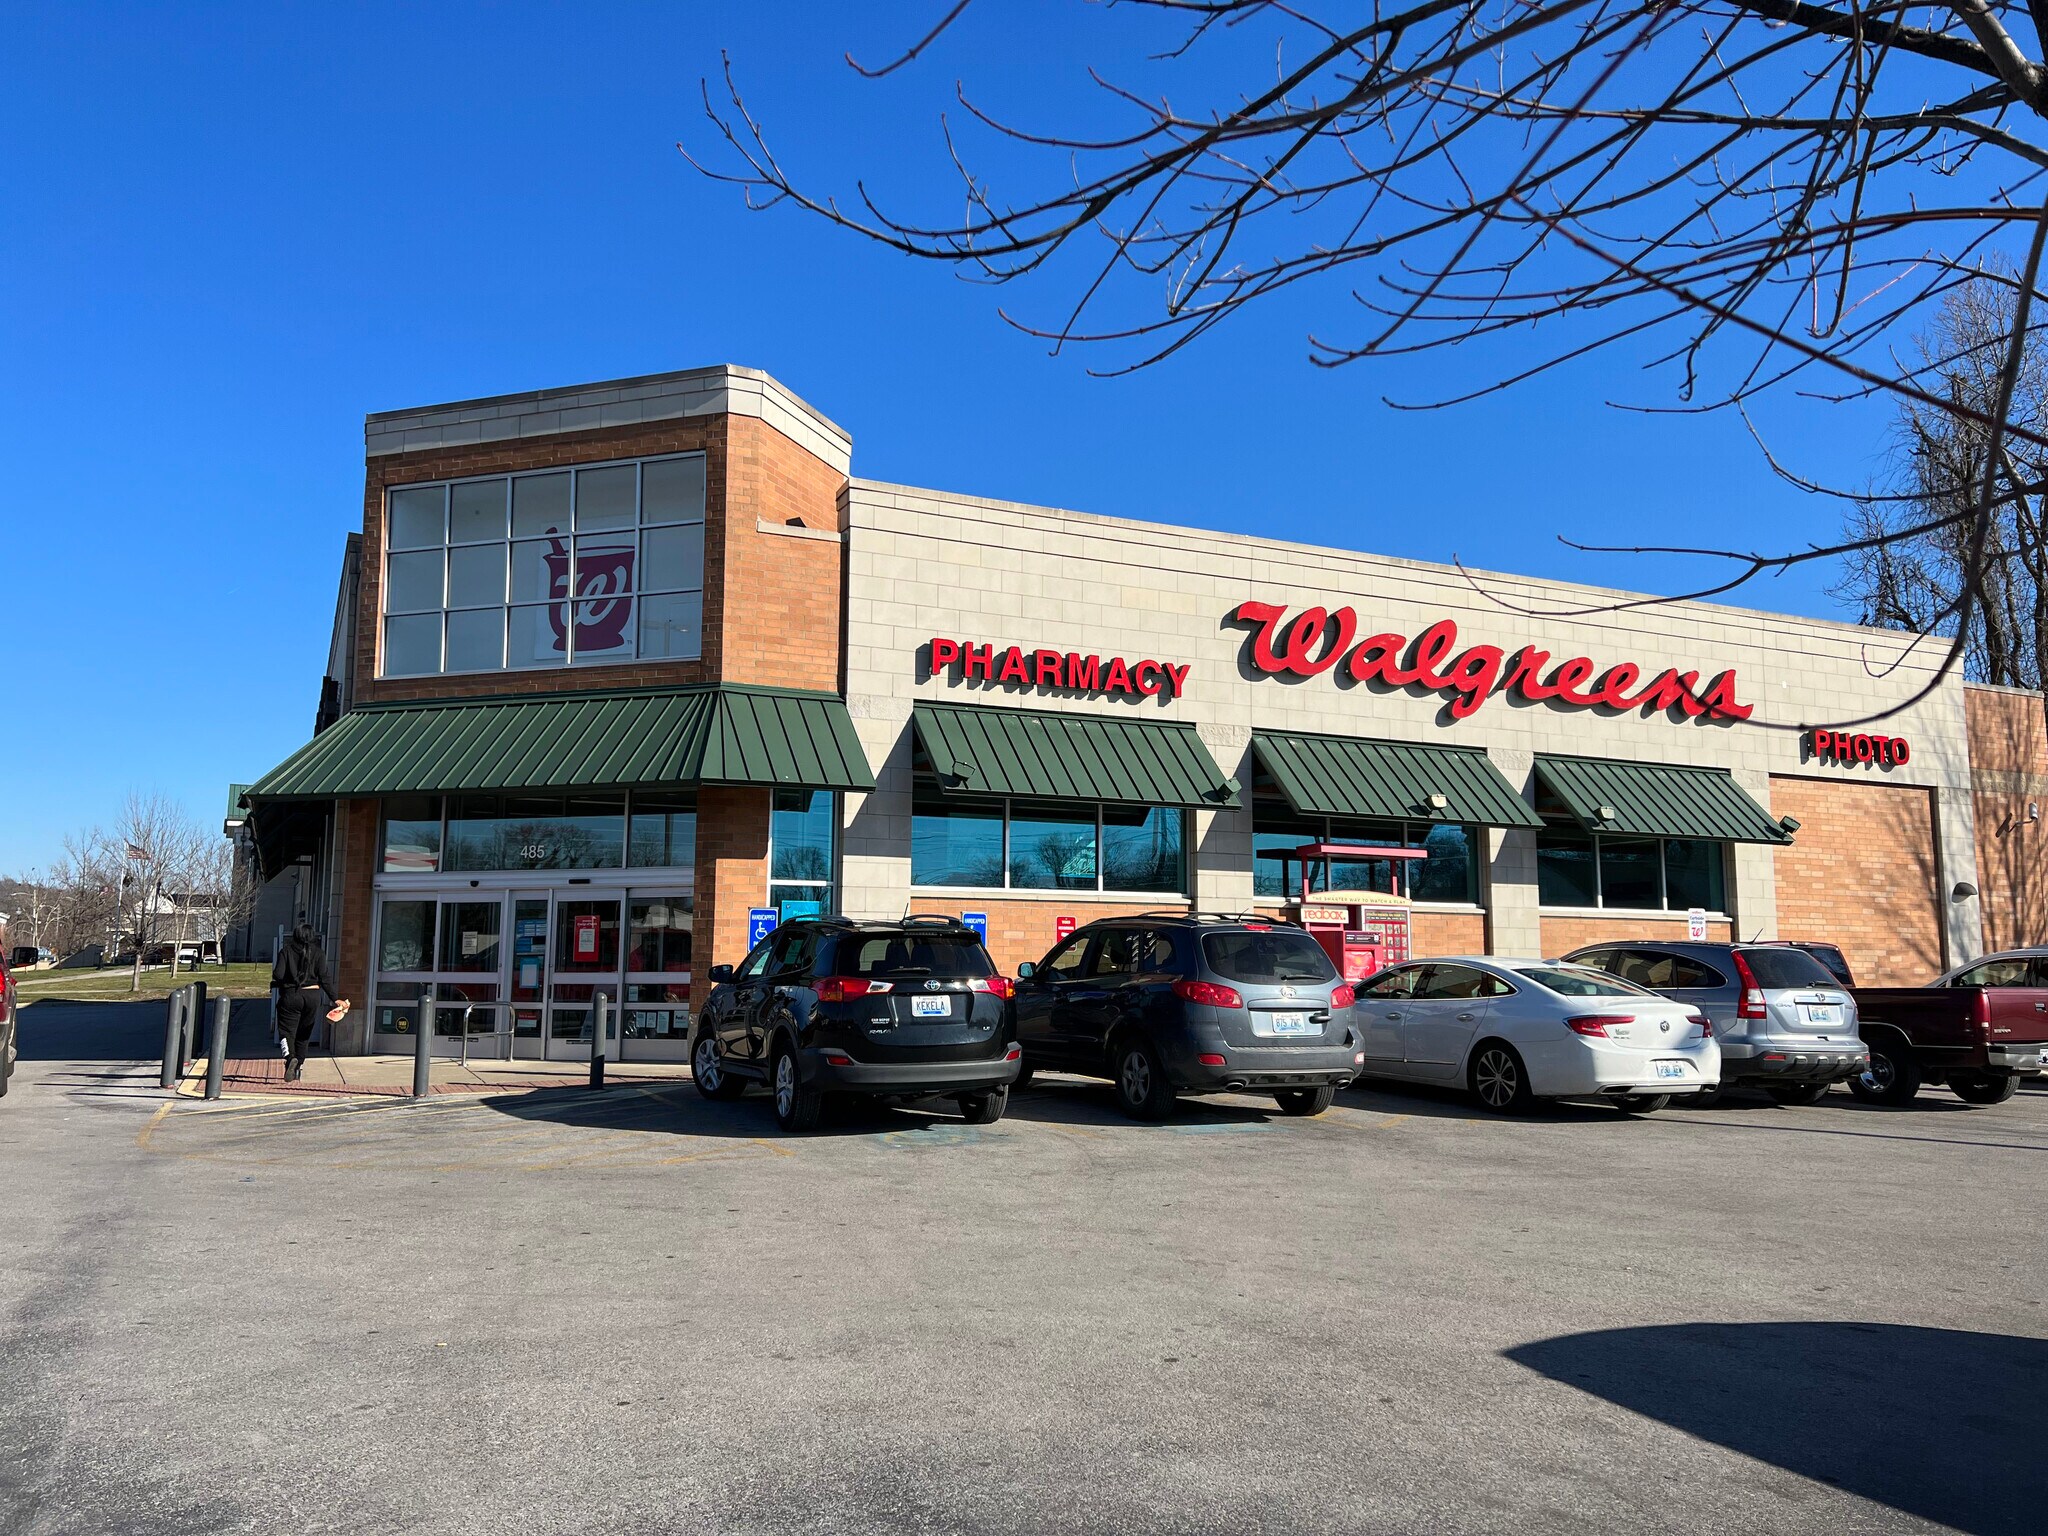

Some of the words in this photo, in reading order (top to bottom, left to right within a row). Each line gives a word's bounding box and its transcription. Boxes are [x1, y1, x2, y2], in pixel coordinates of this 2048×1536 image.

[930, 638, 1191, 698] PHARMACY
[1237, 600, 1753, 720] Walgreens
[1813, 729, 1910, 766] PHOTO
[520, 845, 545, 859] 485
[916, 1001, 945, 1011] KEKELA
[1276, 1018, 1287, 1027] 875
